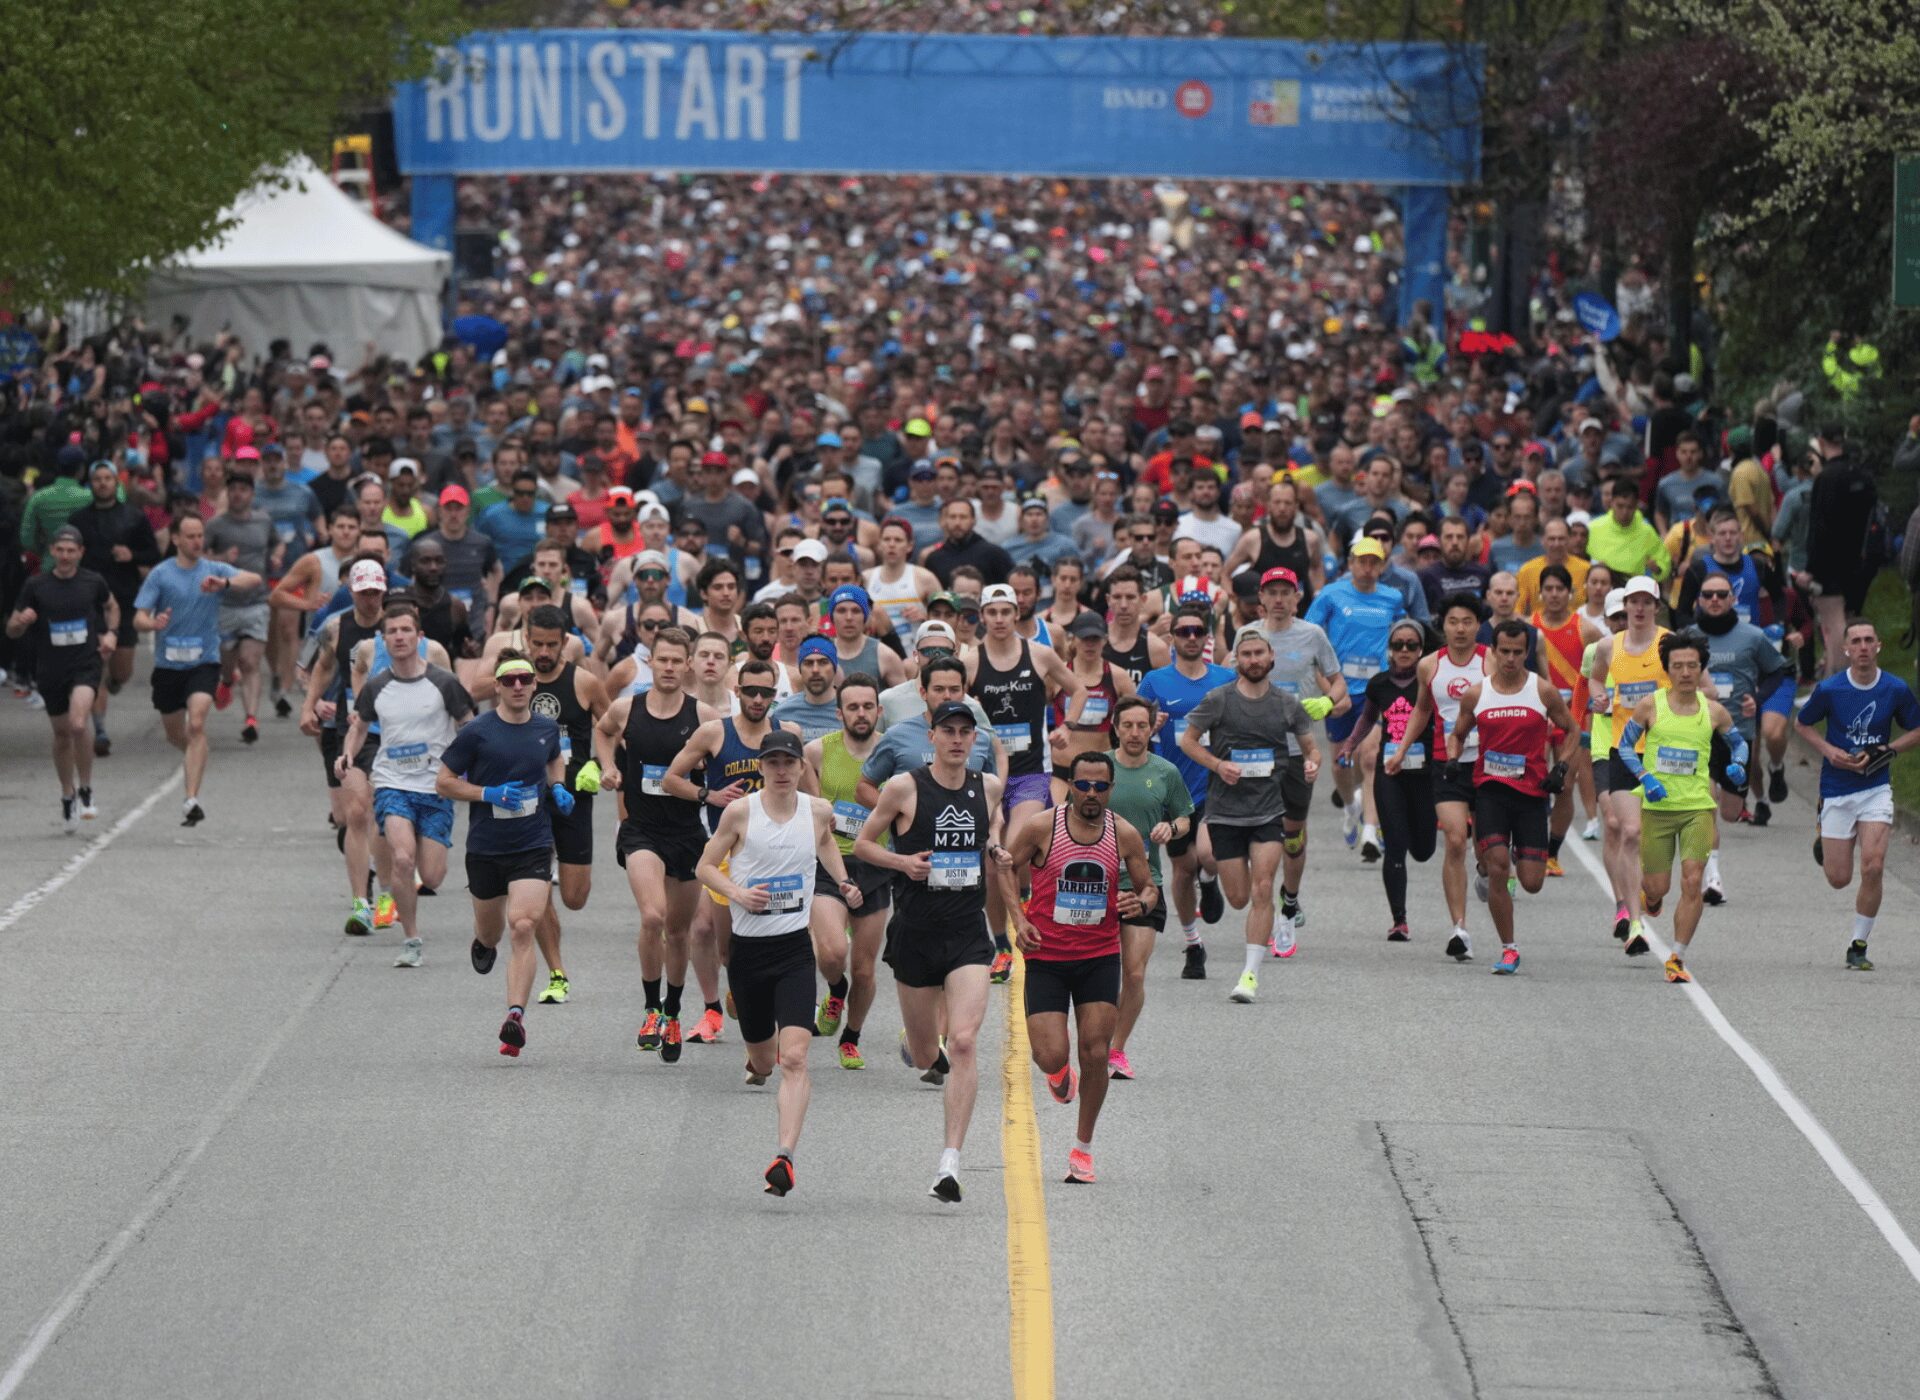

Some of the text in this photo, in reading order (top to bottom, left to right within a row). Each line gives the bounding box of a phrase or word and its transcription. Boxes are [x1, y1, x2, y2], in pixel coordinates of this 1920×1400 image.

[426, 43, 812, 142] RUN START
[1487, 709, 1528, 719] CANADA
[725, 758, 761, 777] COLLIN
[945, 868, 968, 878] JUSTIN
